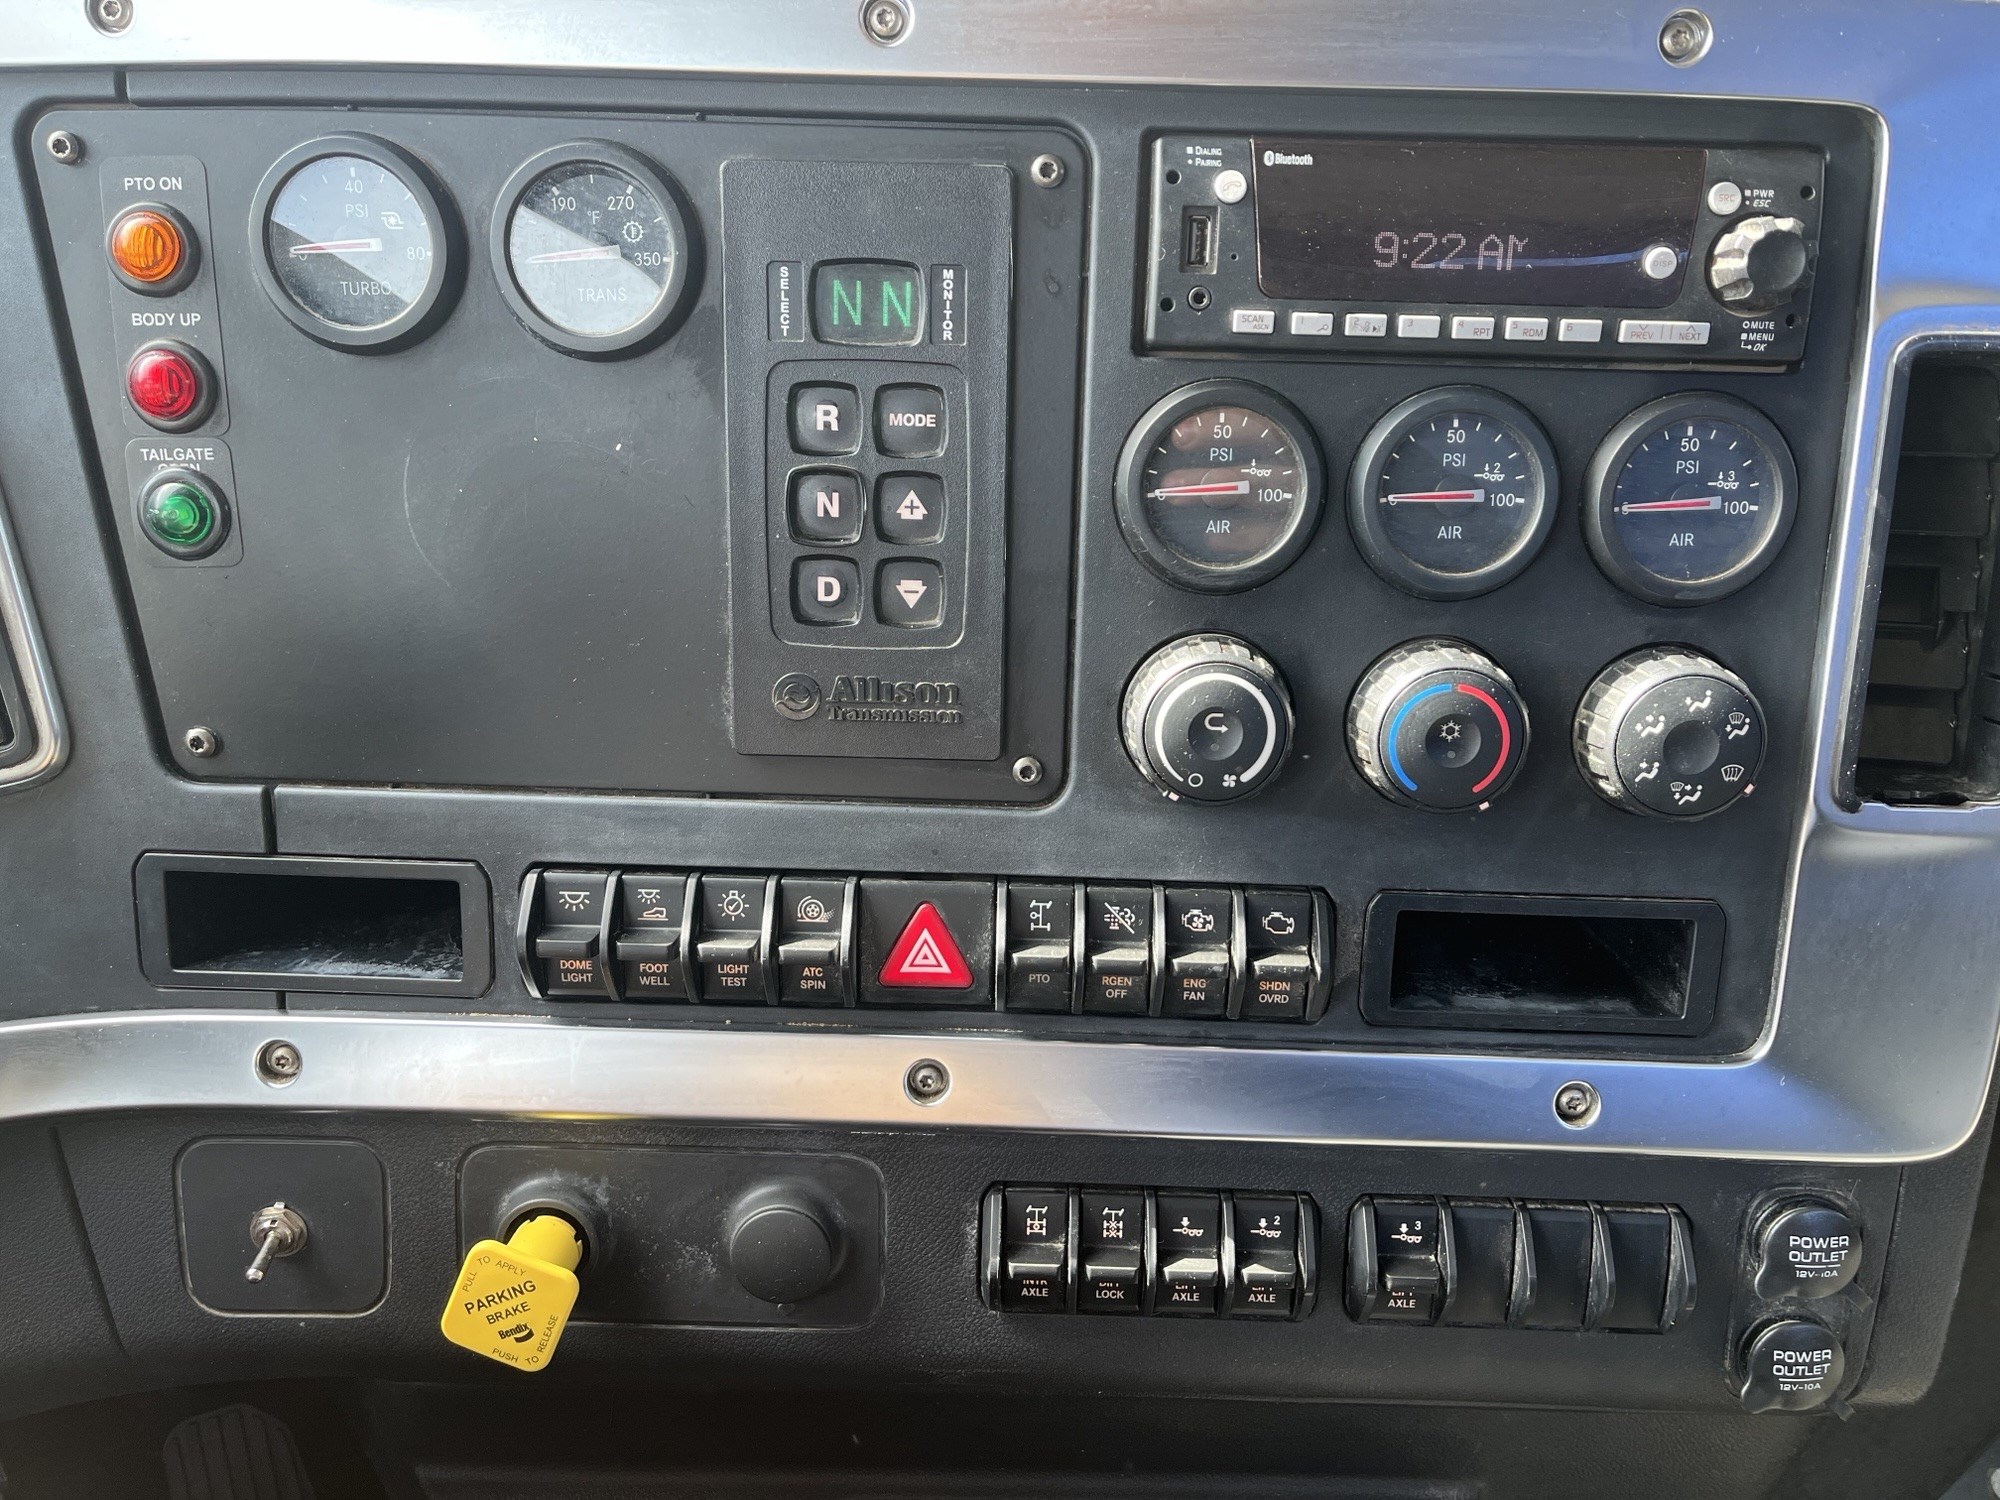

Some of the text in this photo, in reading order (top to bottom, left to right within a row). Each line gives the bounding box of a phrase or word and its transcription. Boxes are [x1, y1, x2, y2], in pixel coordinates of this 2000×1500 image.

[1274, 153, 1313, 166] Bluetooth
[124, 177, 183, 191] PTO ON
[344, 180, 363, 194] 40
[1753, 189, 1775, 198] PWR
[551, 197, 576, 211] 190
[607, 196, 634, 210] 270
[1752, 199, 1771, 207] ESC
[345, 204, 369, 218] PSI
[406, 247, 425, 261] 80
[1373, 231, 1466, 269] 9:22
[634, 252, 661, 267] 350
[340, 281, 392, 296] TURBO
[577, 288, 627, 302] TRANS
[780, 266, 790, 337] SELECT
[832, 279, 912, 327] N N
[943, 269, 954, 341] MONITOR
[132, 313, 201, 326] BODY UP
[1241, 315, 1264, 323] SCAN
[1751, 321, 1775, 330] MUTE
[1473, 327, 1491, 336] RPT
[1522, 328, 1544, 337] RDM
[1630, 332, 1654, 340] PREV
[1679, 332, 1701, 341] NEXT
[1748, 333, 1775, 342] MENU
[1753, 343, 1767, 351] OK
[816, 404, 839, 431] R
[889, 413, 936, 427] MODE
[1213, 425, 1232, 439] 50
[1447, 430, 1465, 443] 50
[1680, 438, 1700, 452] 50
[140, 448, 214, 461] TAILGATE
[1210, 448, 1233, 462] PSI
[1443, 453, 1466, 467] PSI
[1493, 463, 1501, 473] 2
[1676, 460, 1700, 474] PSI
[1728, 471, 1735, 481] 3
[1257, 489, 1283, 502] 100
[1490, 493, 1515, 507] 100
[816, 492, 839, 518] N
[1723, 501, 1749, 515] 100
[1206, 520, 1230, 534] AIR
[1437, 526, 1462, 540] AIR
[1669, 533, 1695, 547] AIR
[817, 576, 841, 602] D
[826, 675, 961, 704] Allison
[827, 705, 962, 724] Transmission
[560, 959, 592, 970] DOME
[639, 963, 668, 974] FOOT
[717, 963, 750, 975] LIGHT
[561, 972, 593, 983] LIGHT
[802, 966, 823, 977] ATC
[639, 975, 670, 986] WELL
[720, 976, 747, 987] TEST
[800, 979, 826, 990] SPIN
[1028, 974, 1050, 984] PTO
[1102, 977, 1132, 987] RGEN
[1183, 978, 1206, 988] ENG
[1259, 981, 1291, 991] SHDN
[1105, 988, 1127, 999] OFF
[1183, 990, 1205, 1001] FAN
[1258, 993, 1289, 1004] OVRD
[1273, 1215, 1281, 1225] 2
[1414, 1221, 1422, 1230] 3
[1789, 1235, 1849, 1249] POWER
[1788, 1250, 1849, 1263] OUTLET
[462, 1255, 526, 1292] PULL TO APPLY
[464, 1279, 537, 1315] PARKING
[1021, 1287, 1049, 1297] AXLE
[1095, 1290, 1125, 1299] LOCK
[1172, 1292, 1200, 1302] AXLE
[1247, 1293, 1276, 1303] AXLE
[1387, 1298, 1416, 1309] AXLE
[485, 1301, 531, 1325] BRAKE
[498, 1322, 530, 1340] Bendix
[492, 1314, 559, 1366] PUSH TO RELEASE
[1773, 1349, 1832, 1363] POWER
[1772, 1363, 1831, 1377] OUTLET
[1779, 1382, 1821, 1391] 12V-10A
